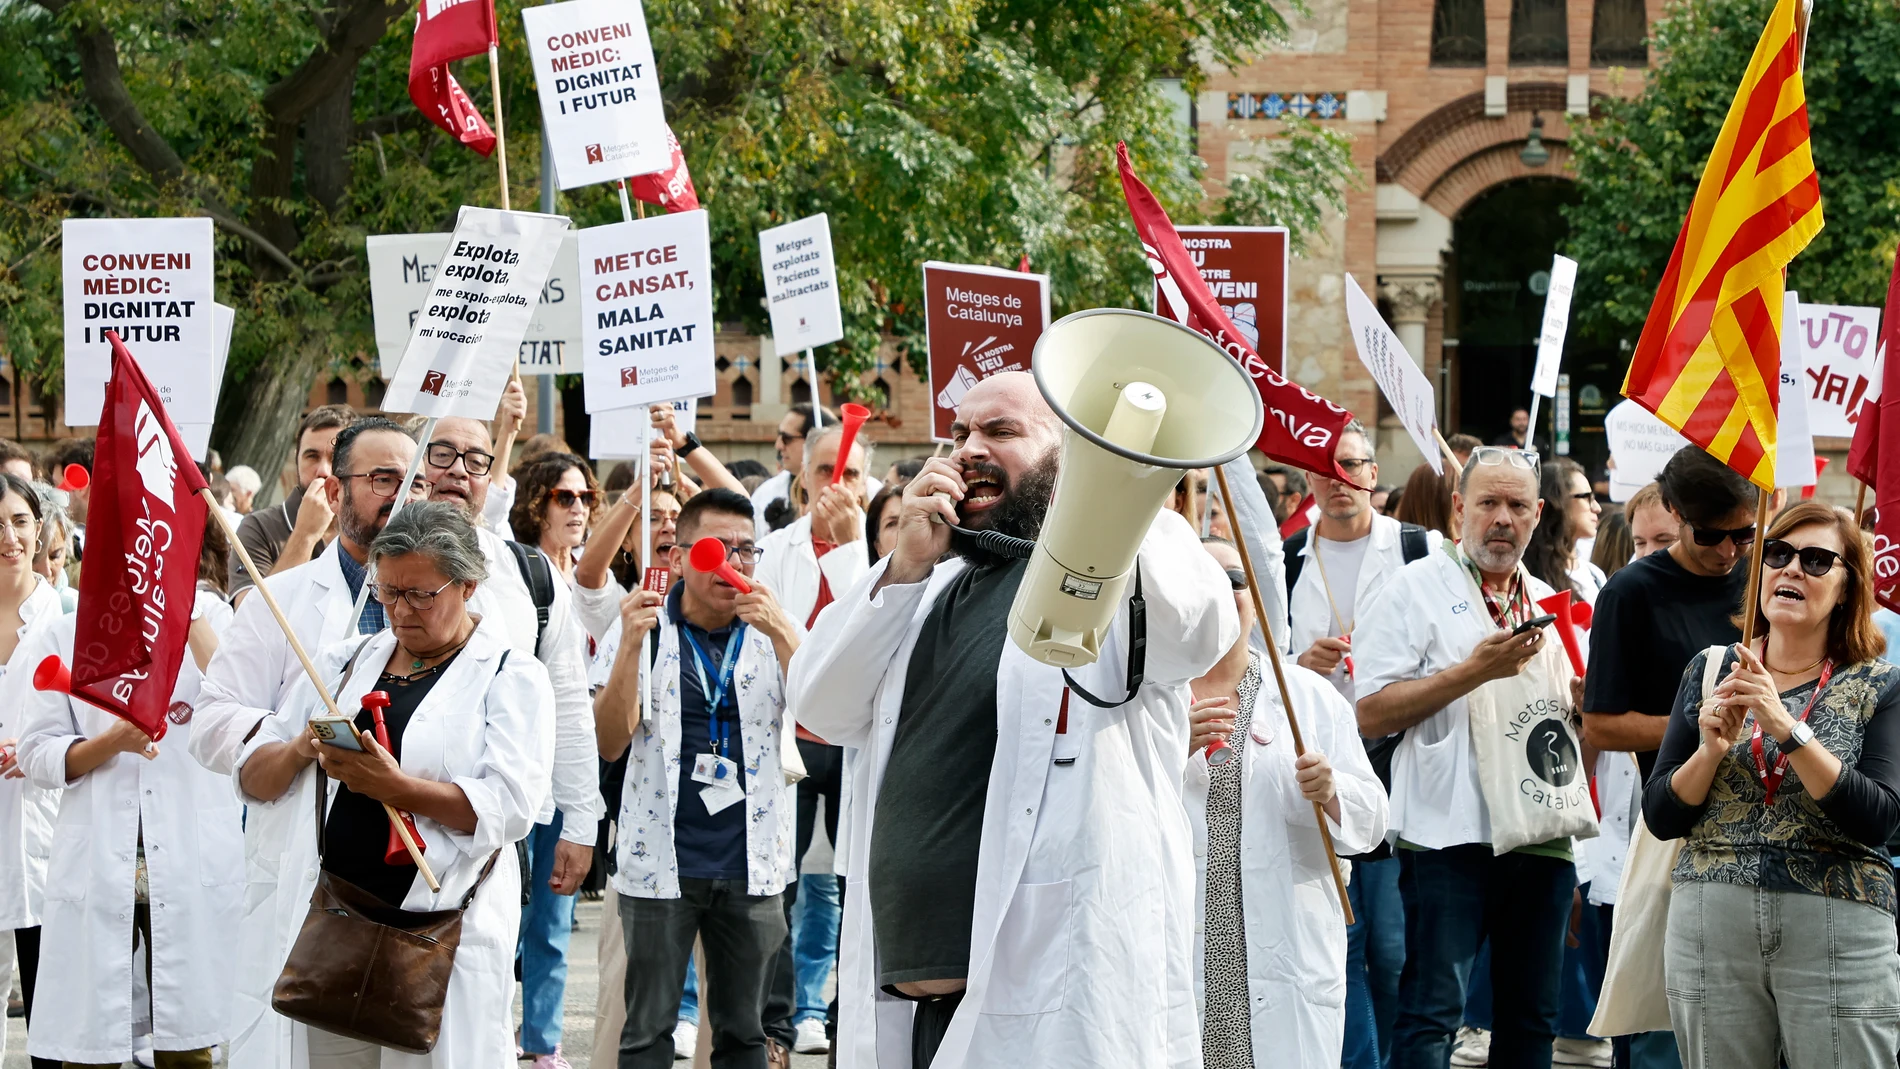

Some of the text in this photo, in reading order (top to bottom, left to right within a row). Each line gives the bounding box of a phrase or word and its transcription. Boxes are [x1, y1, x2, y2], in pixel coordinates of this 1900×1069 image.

[547, 22, 632, 52] CONVENI
[550, 47, 621, 73] MÈDIC:
[555, 63, 642, 94] DIGNITAT
[559, 87, 637, 115] I FUTUR
[603, 143, 629, 153] Metges
[605, 149, 640, 161] Catalunya
[453, 241, 520, 268] Explota,
[776, 235, 813, 254] Metges
[1182, 238, 1232, 249] NOSTRA
[82, 252, 192, 272] CONVENI
[594, 245, 678, 275] METGE
[772, 250, 820, 272] explotats
[83, 274, 171, 296] MÈDIC:
[445, 263, 510, 287] explota,
[596, 270, 694, 302] CANSAT,
[776, 265, 820, 286] Pacients
[435, 288, 453, 298] me
[772, 279, 829, 303] maltractats
[945, 286, 1021, 308] Metges de
[84, 301, 196, 319] DIGNITAT
[428, 303, 491, 325] explota
[597, 303, 665, 330] MALA
[947, 304, 1022, 327] Catalunya
[84, 325, 181, 343] I FUTUR
[419, 327, 482, 344] mi vocación
[598, 324, 696, 357] SANITAT
[973, 343, 1014, 362] LA NOSTRA
[976, 355, 1004, 372] VEU
[639, 366, 667, 378] Metges
[639, 373, 680, 385] Catalunya
